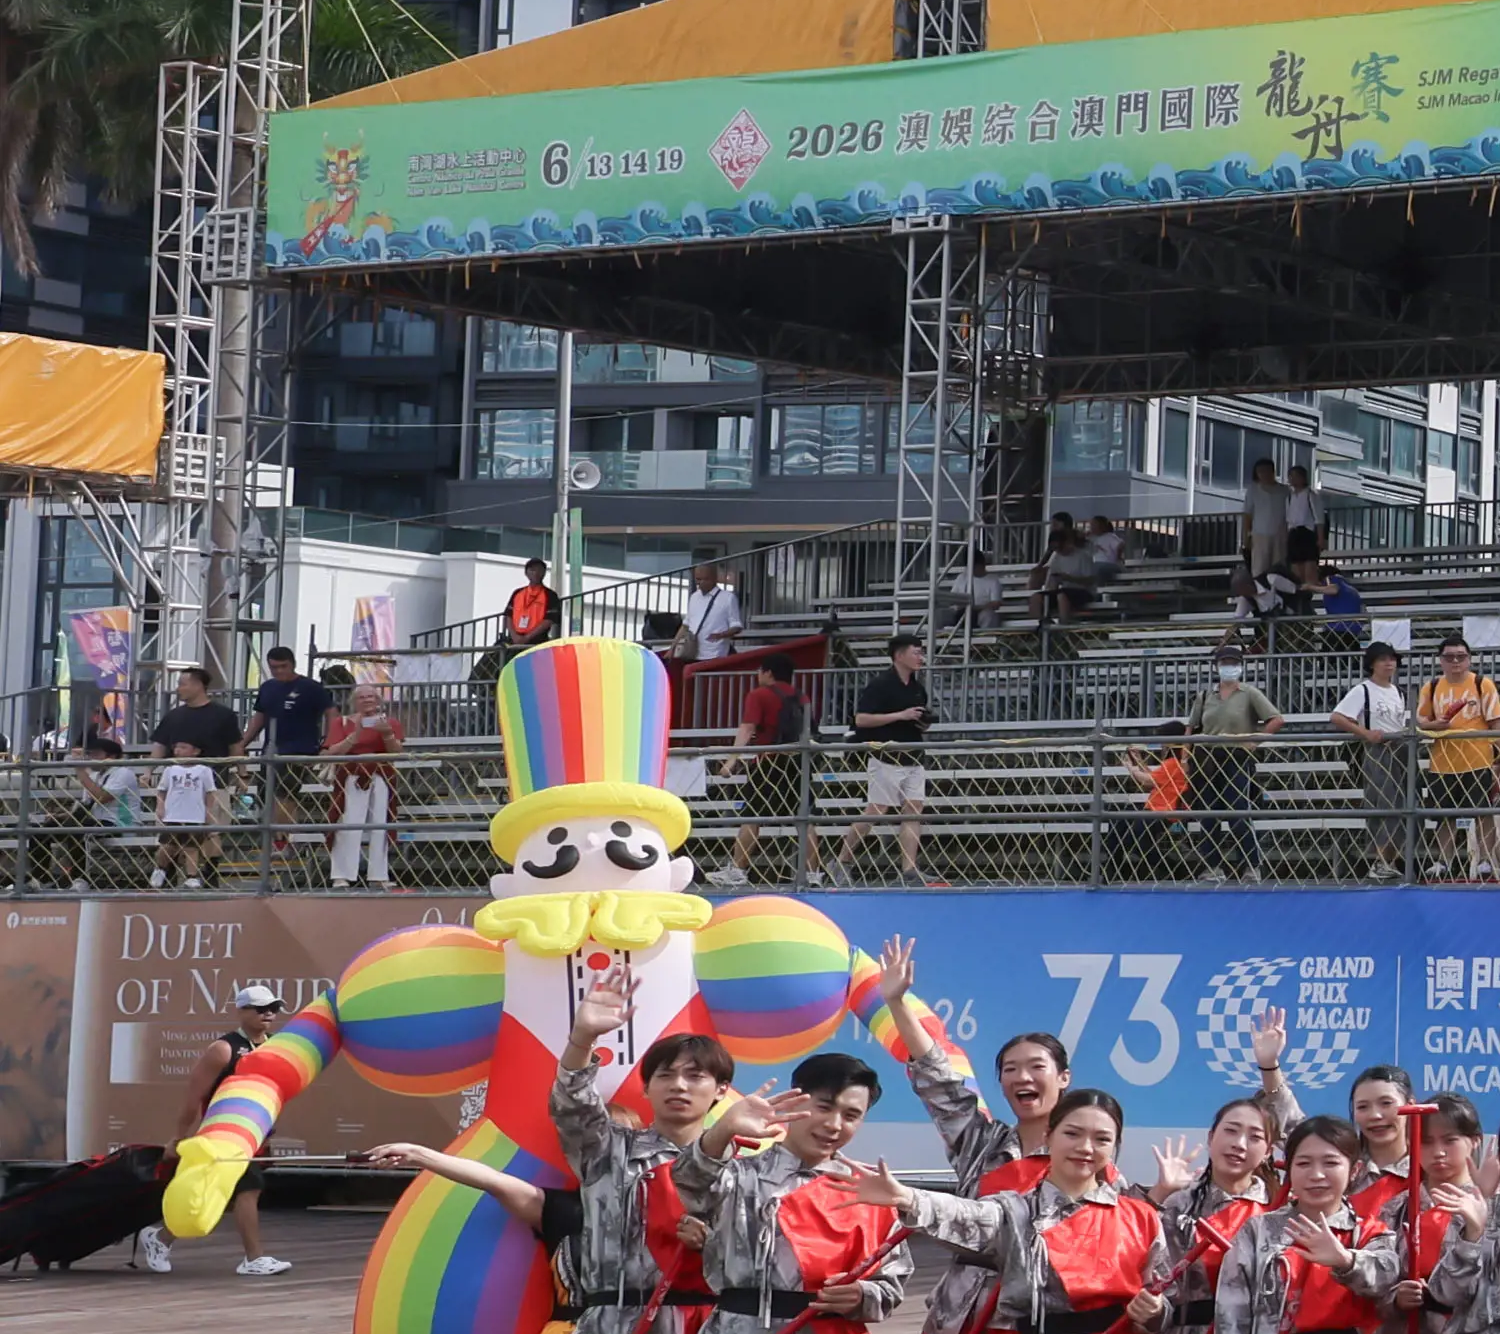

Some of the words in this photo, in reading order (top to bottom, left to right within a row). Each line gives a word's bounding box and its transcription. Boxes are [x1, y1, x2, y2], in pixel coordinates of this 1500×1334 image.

[1417, 68, 1453, 88] SJM
[1416, 93, 1445, 110] SJM
[1448, 88, 1491, 107] Macao
[786, 119, 885, 161] 2026
[894, 82, 1243, 155] 澳娛綜合澳門國際
[620, 149, 648, 175] 14
[656, 146, 685, 171] 19
[1298, 956, 1375, 979] GRAND
[1297, 982, 1349, 1004] PRIX
[1041, 953, 1184, 1087] 73
[1295, 1007, 1372, 1031] MACAU
